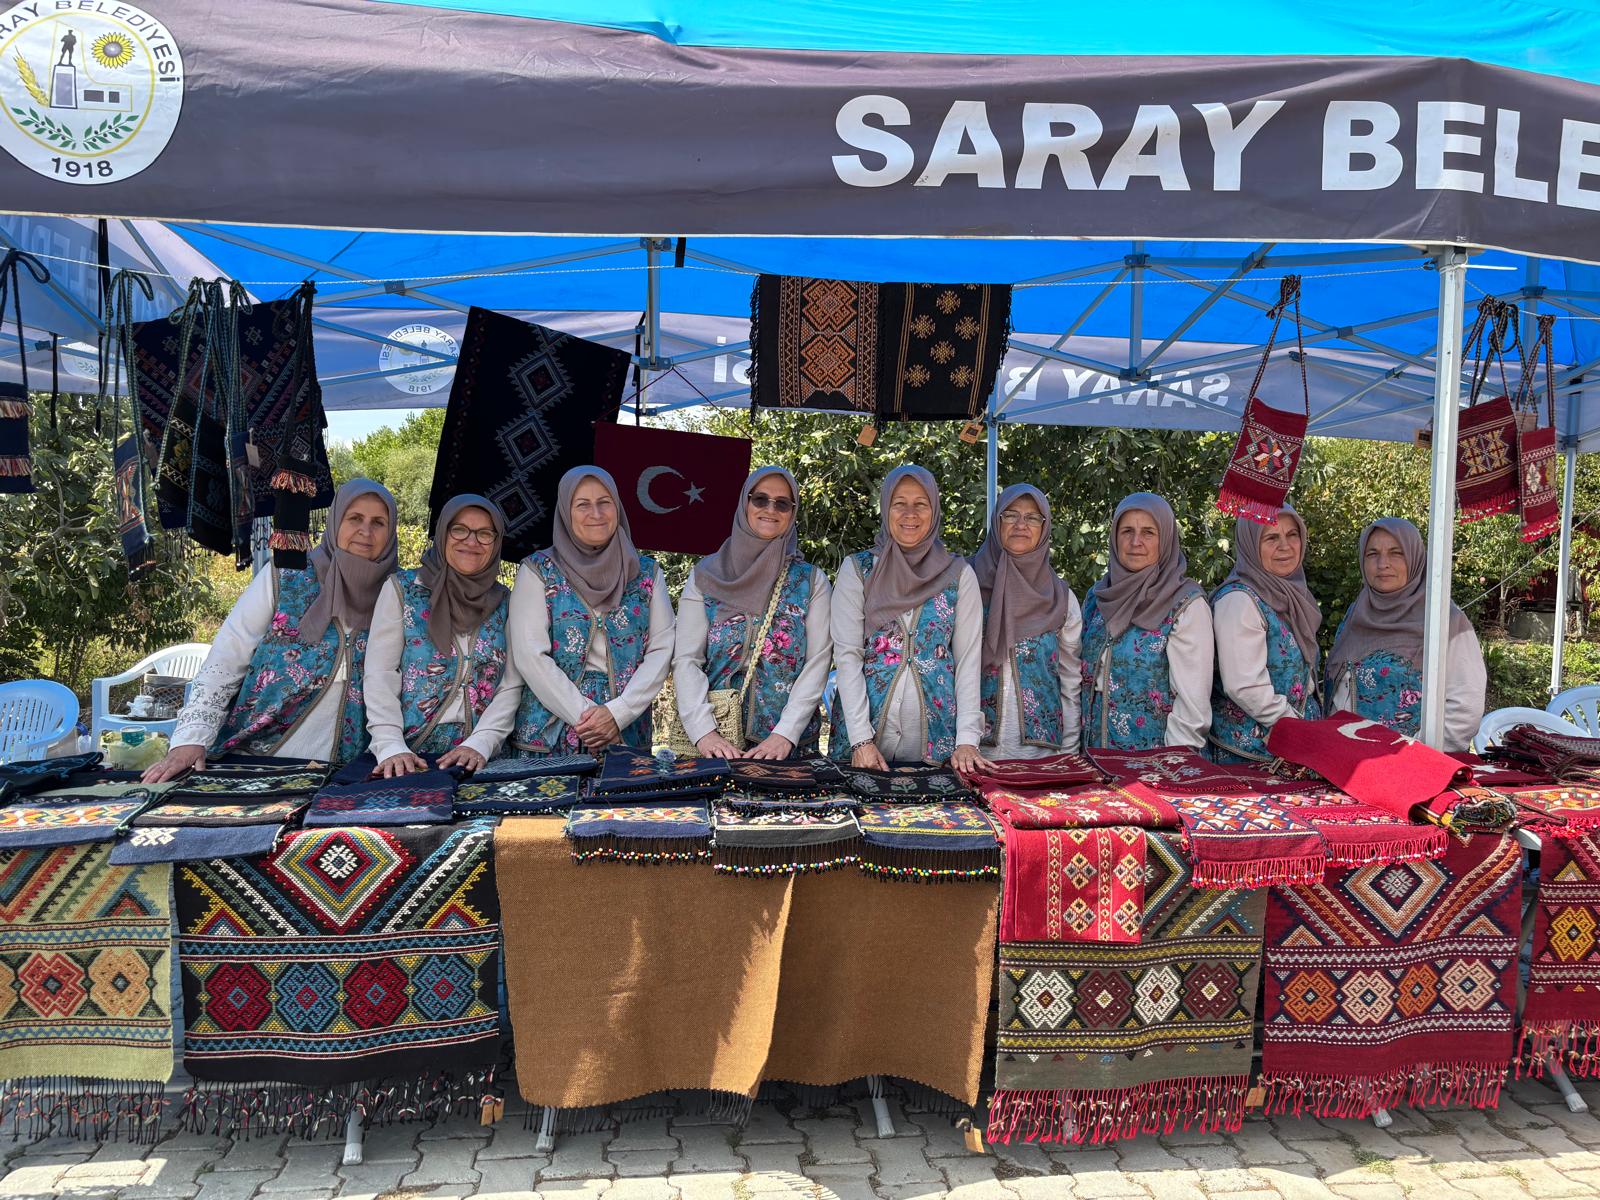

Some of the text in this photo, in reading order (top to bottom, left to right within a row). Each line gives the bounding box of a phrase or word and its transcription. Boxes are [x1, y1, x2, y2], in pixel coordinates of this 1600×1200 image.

[55, 0, 180, 82] BELEDİYESİ
[51, 157, 113, 178] 1918
[831, 95, 1600, 211] SARAY BELE
